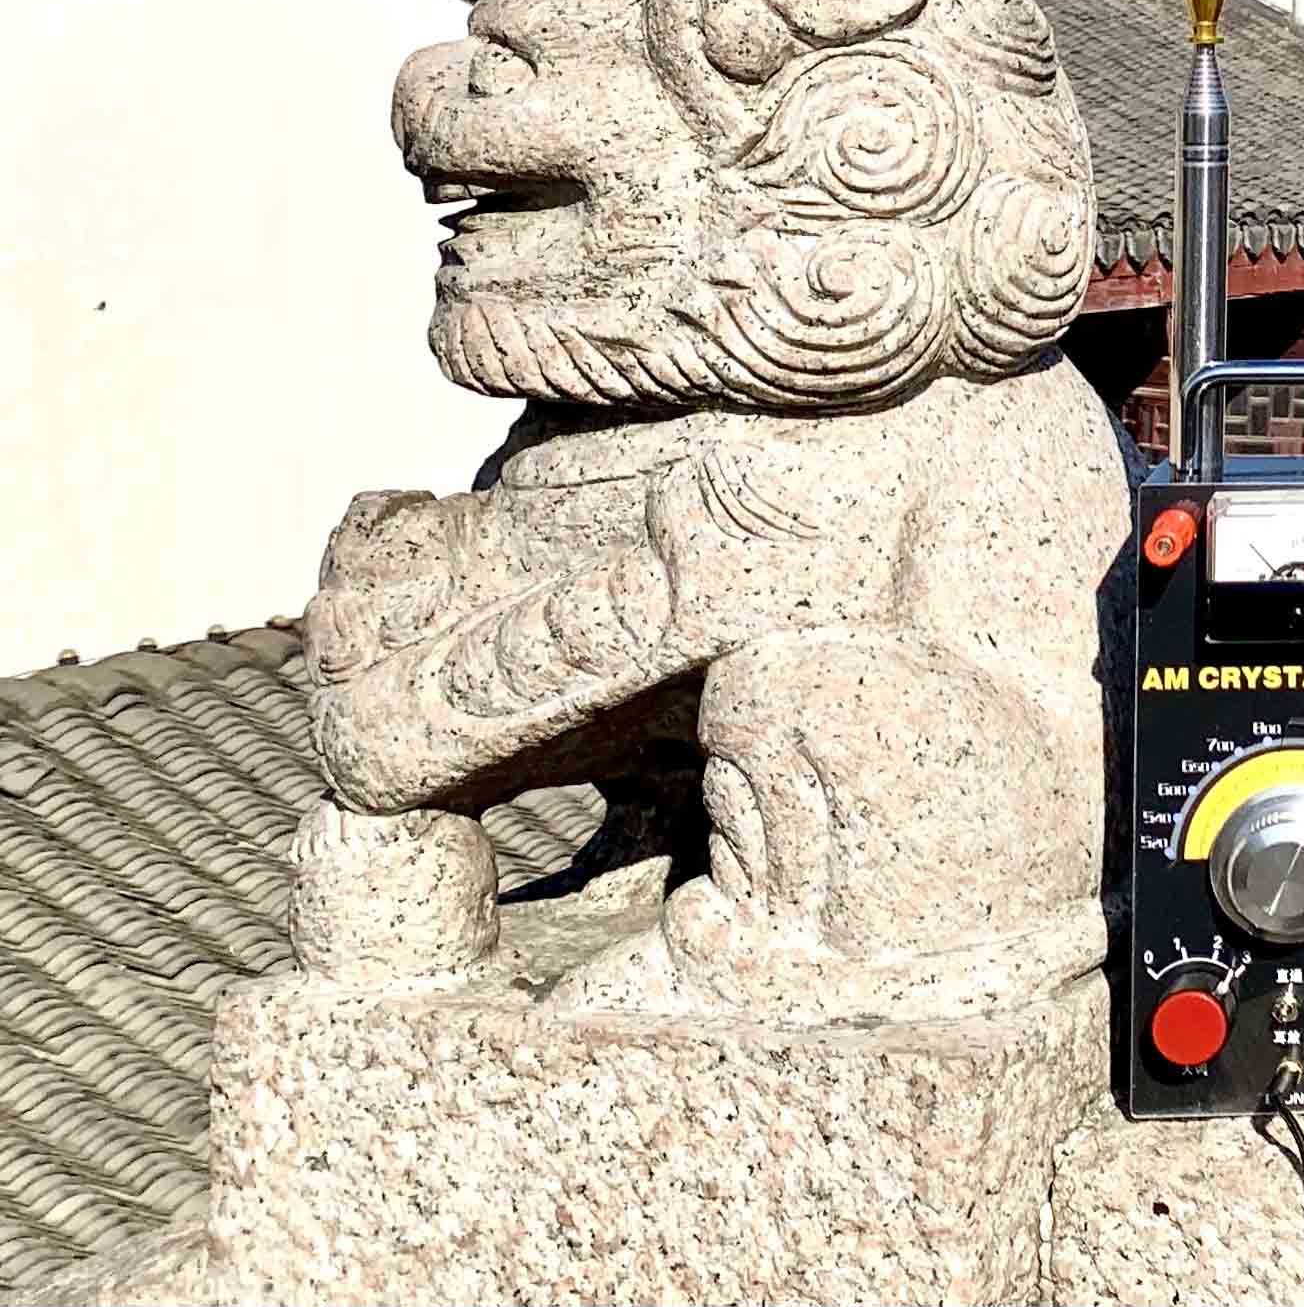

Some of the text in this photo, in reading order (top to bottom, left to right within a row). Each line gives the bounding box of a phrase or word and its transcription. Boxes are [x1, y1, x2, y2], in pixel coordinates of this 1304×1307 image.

[1142, 667, 1189, 691] AM
[1252, 721, 1282, 735] 800
[1206, 737, 1234, 752] 700
[1158, 782, 1187, 796] 600
[1173, 937, 1181, 951] 1
[1213, 935, 1223, 949] 2
[1143, 950, 1154, 964] 0
[1241, 950, 1252, 964] 3
